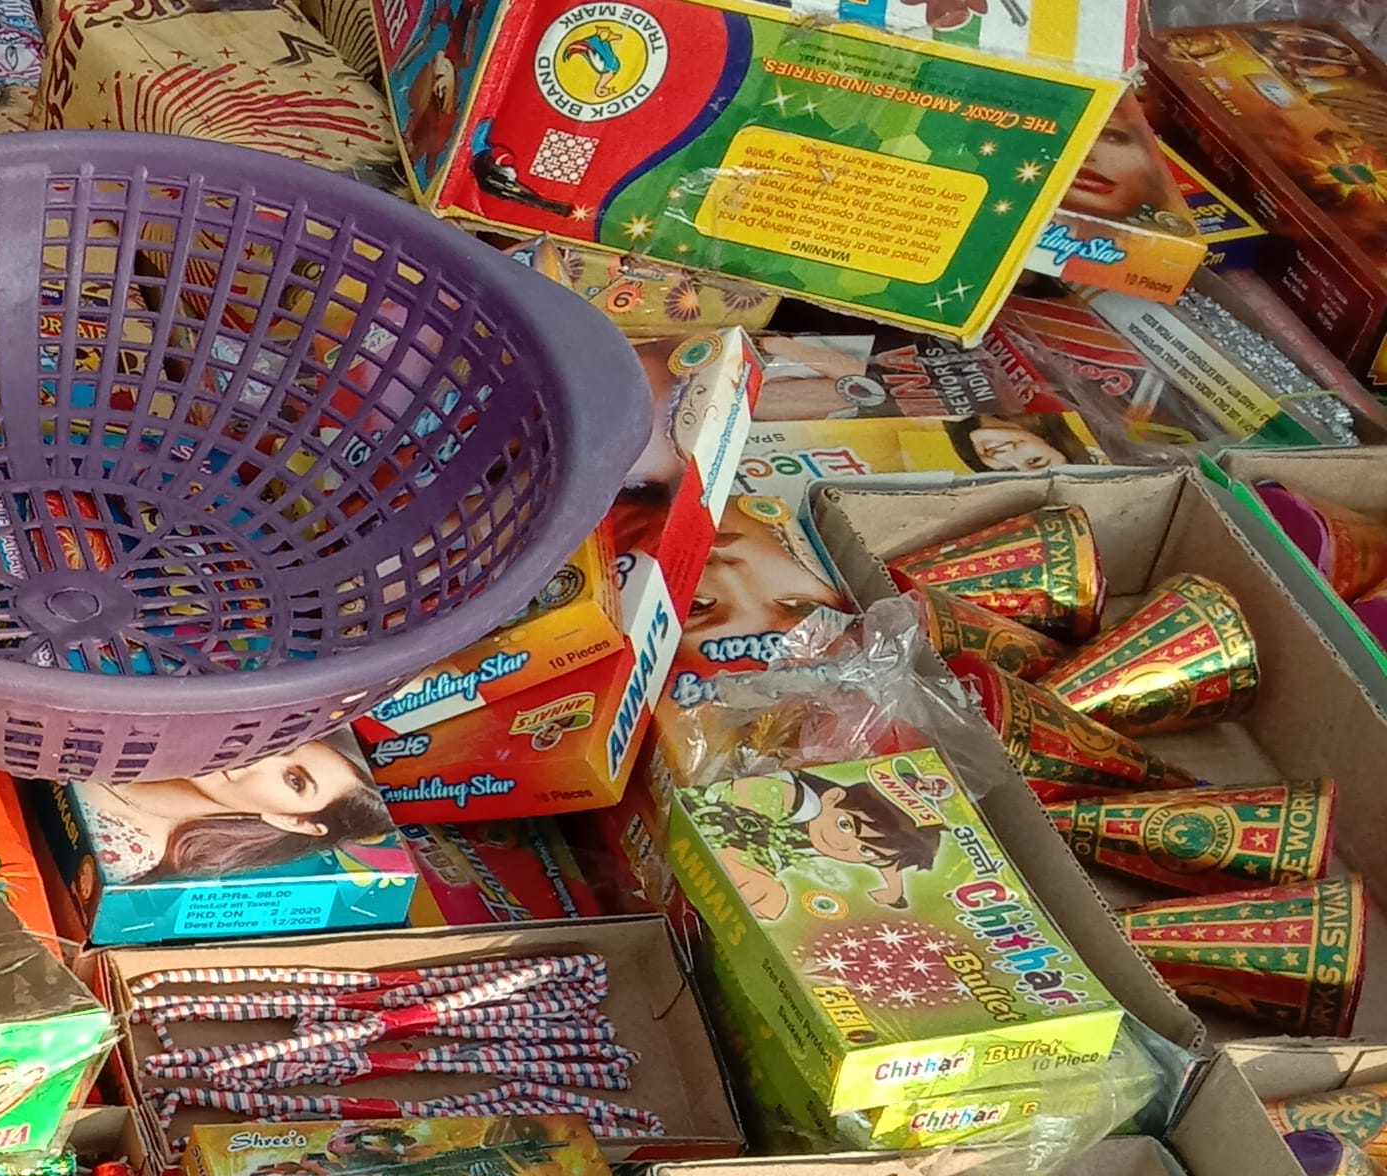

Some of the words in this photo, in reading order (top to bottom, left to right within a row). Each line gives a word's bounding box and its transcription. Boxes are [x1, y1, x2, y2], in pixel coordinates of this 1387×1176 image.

[558, 1, 619, 30] MARK
[619, 5, 668, 55] TRADE
[537, 54, 585, 118] BRAND
[760, 54, 872, 95] INDUSTRIES,
[589, 82, 651, 120] DUCK
[870, 79, 962, 115] AMORCES
[961, 101, 1022, 130] Classic
[1021, 114, 1058, 136] THE
[906, 169, 931, 181] and
[872, 191, 908, 204] under
[909, 183, 937, 196] caps
[907, 238, 941, 254] throw
[915, 227, 941, 240] from
[866, 243, 890, 257] and
[478, 651, 531, 686] Star
[548, 657, 567, 671] 10
[567, 641, 611, 665] Pieces
[606, 600, 672, 780] ANNAI'S
[469, 773, 515, 797] Star
[671, 838, 747, 947] ANNAI'S
[183, 921, 214, 931] Best
[216, 919, 259, 930] before
[222, 910, 244, 919] ON
[874, 1055, 967, 1082] Chithar
[983, 1040, 1061, 1066] Bullet
[910, 1105, 1001, 1131] Chithar
[227, 1130, 308, 1152] Shree's
